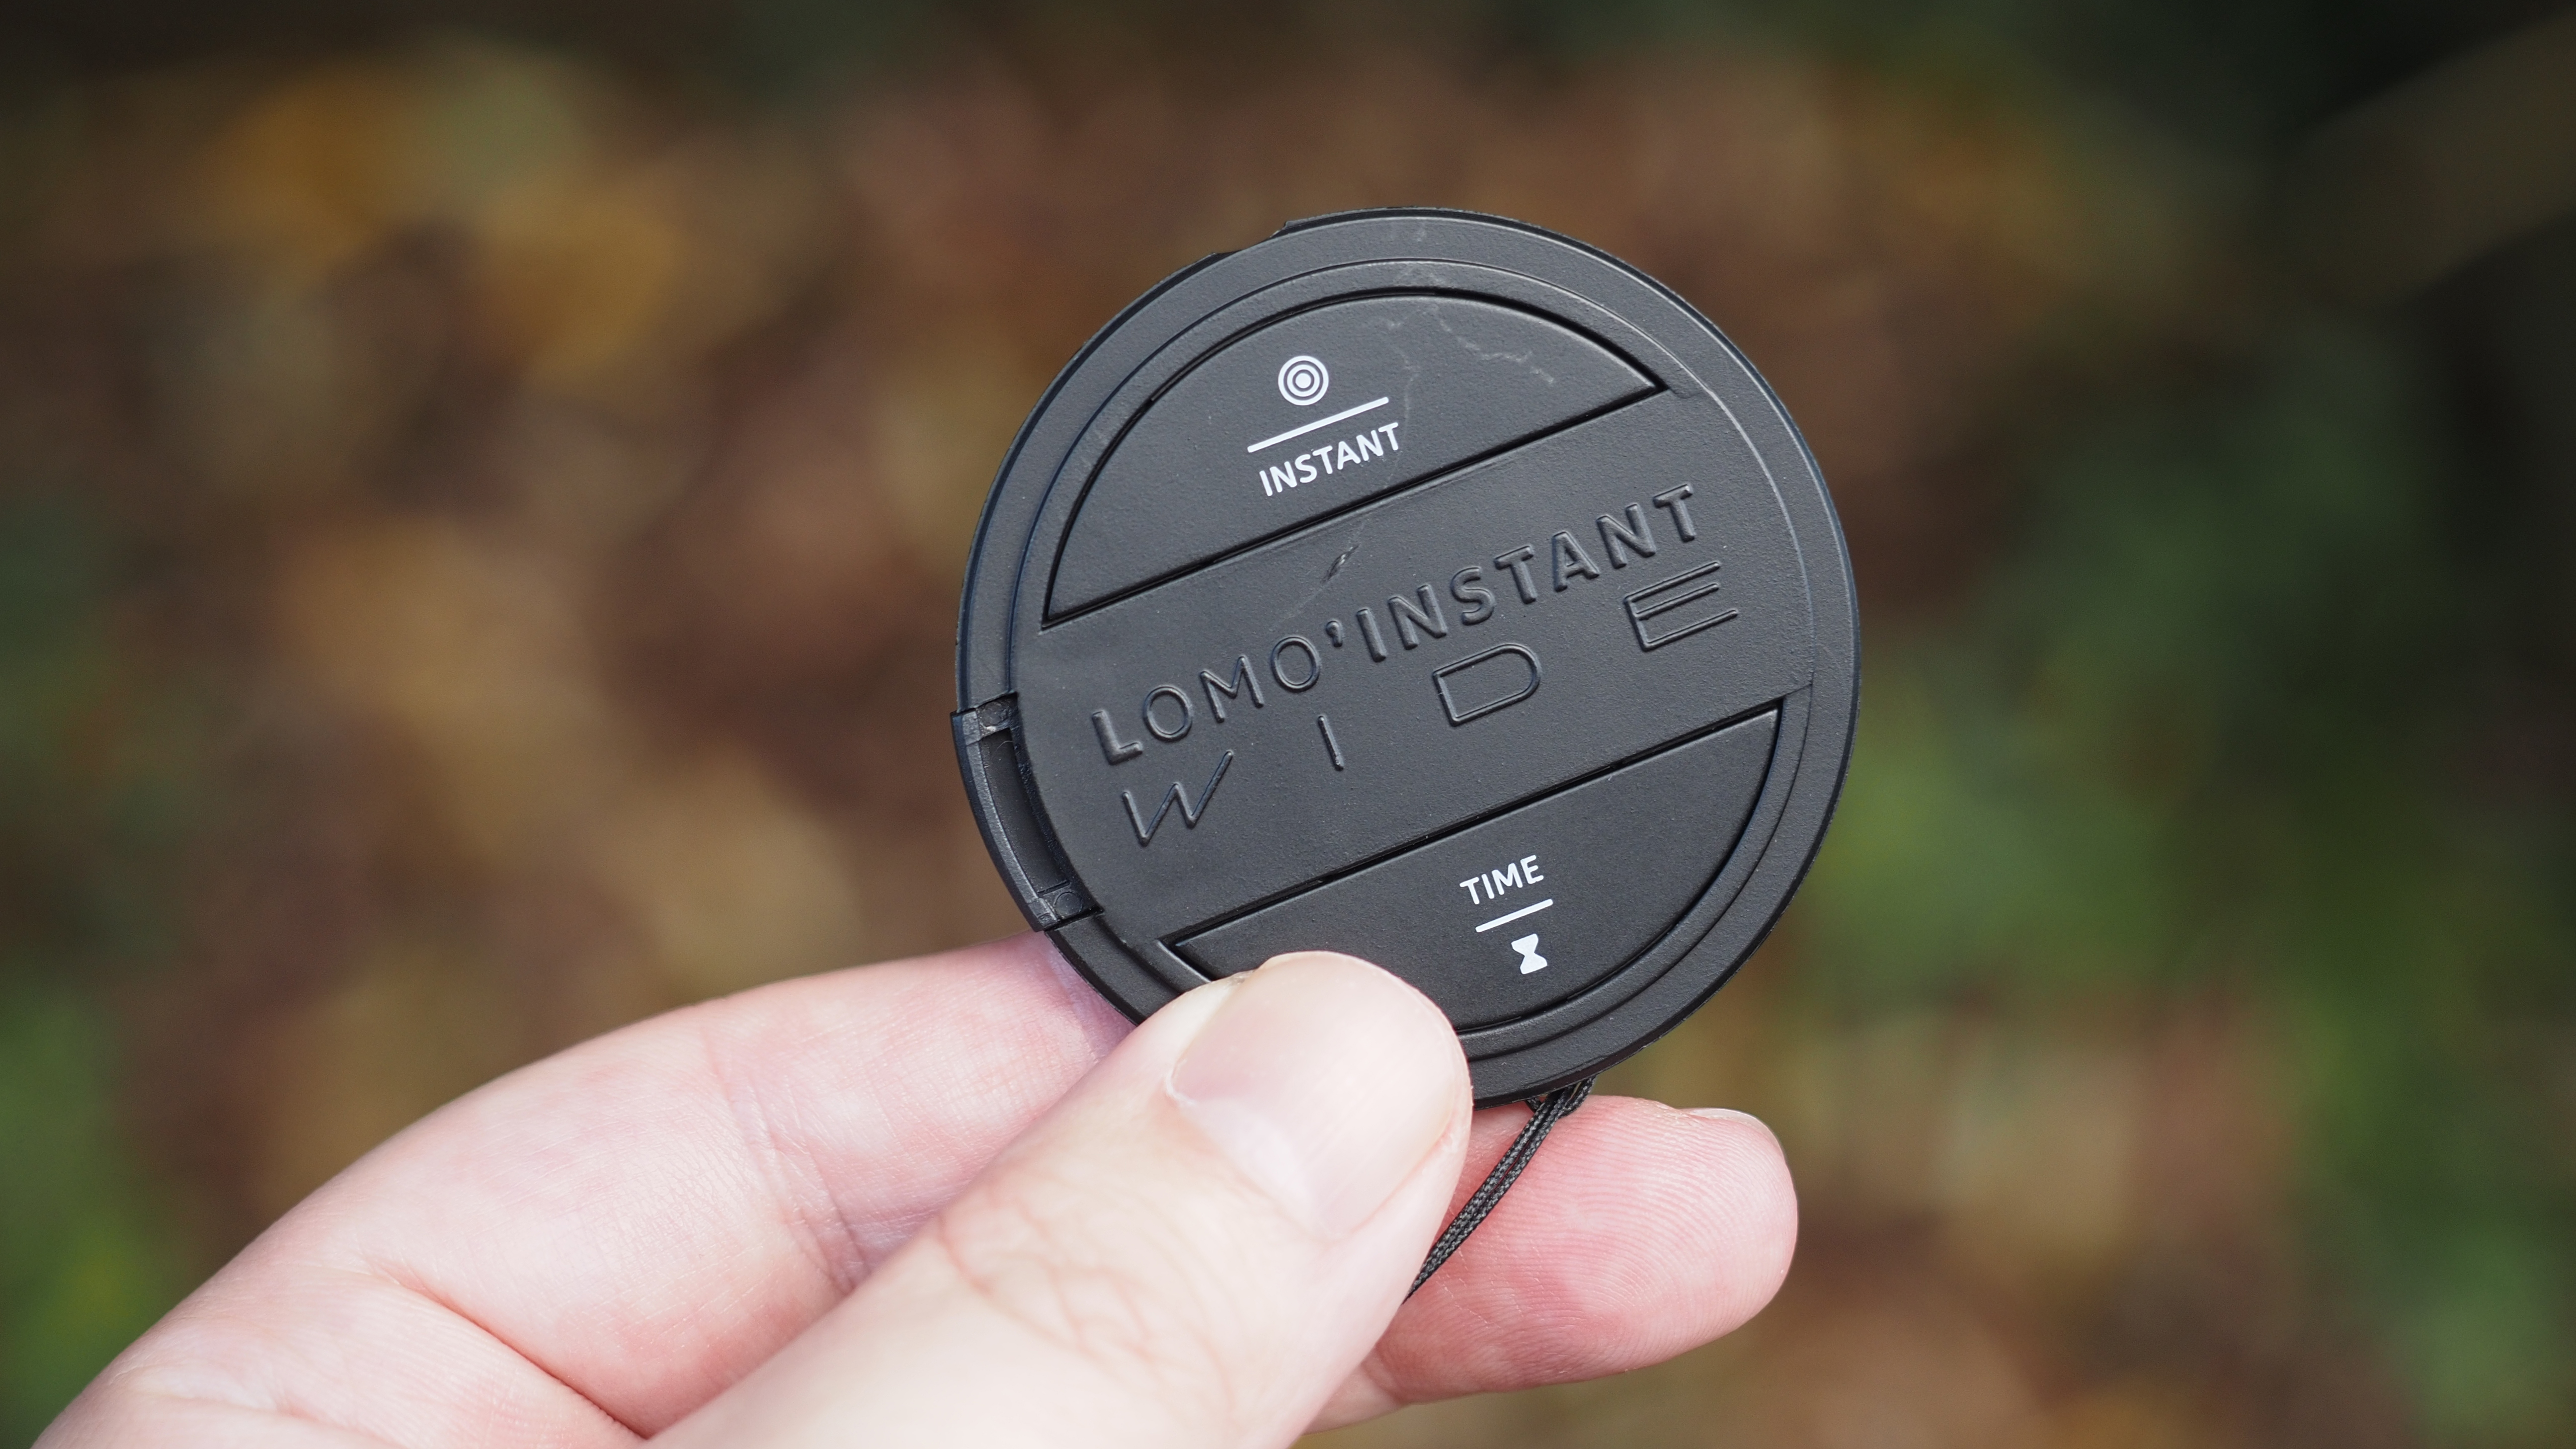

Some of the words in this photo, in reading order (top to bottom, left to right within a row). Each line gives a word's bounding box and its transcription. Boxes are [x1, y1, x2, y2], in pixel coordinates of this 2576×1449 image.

[1259, 421, 1399, 497] INSTANT
[1093, 483, 1698, 765] LOMO'INSTANT
[1122, 562, 1738, 845] WIDE
[1458, 855, 1544, 905] TIME
